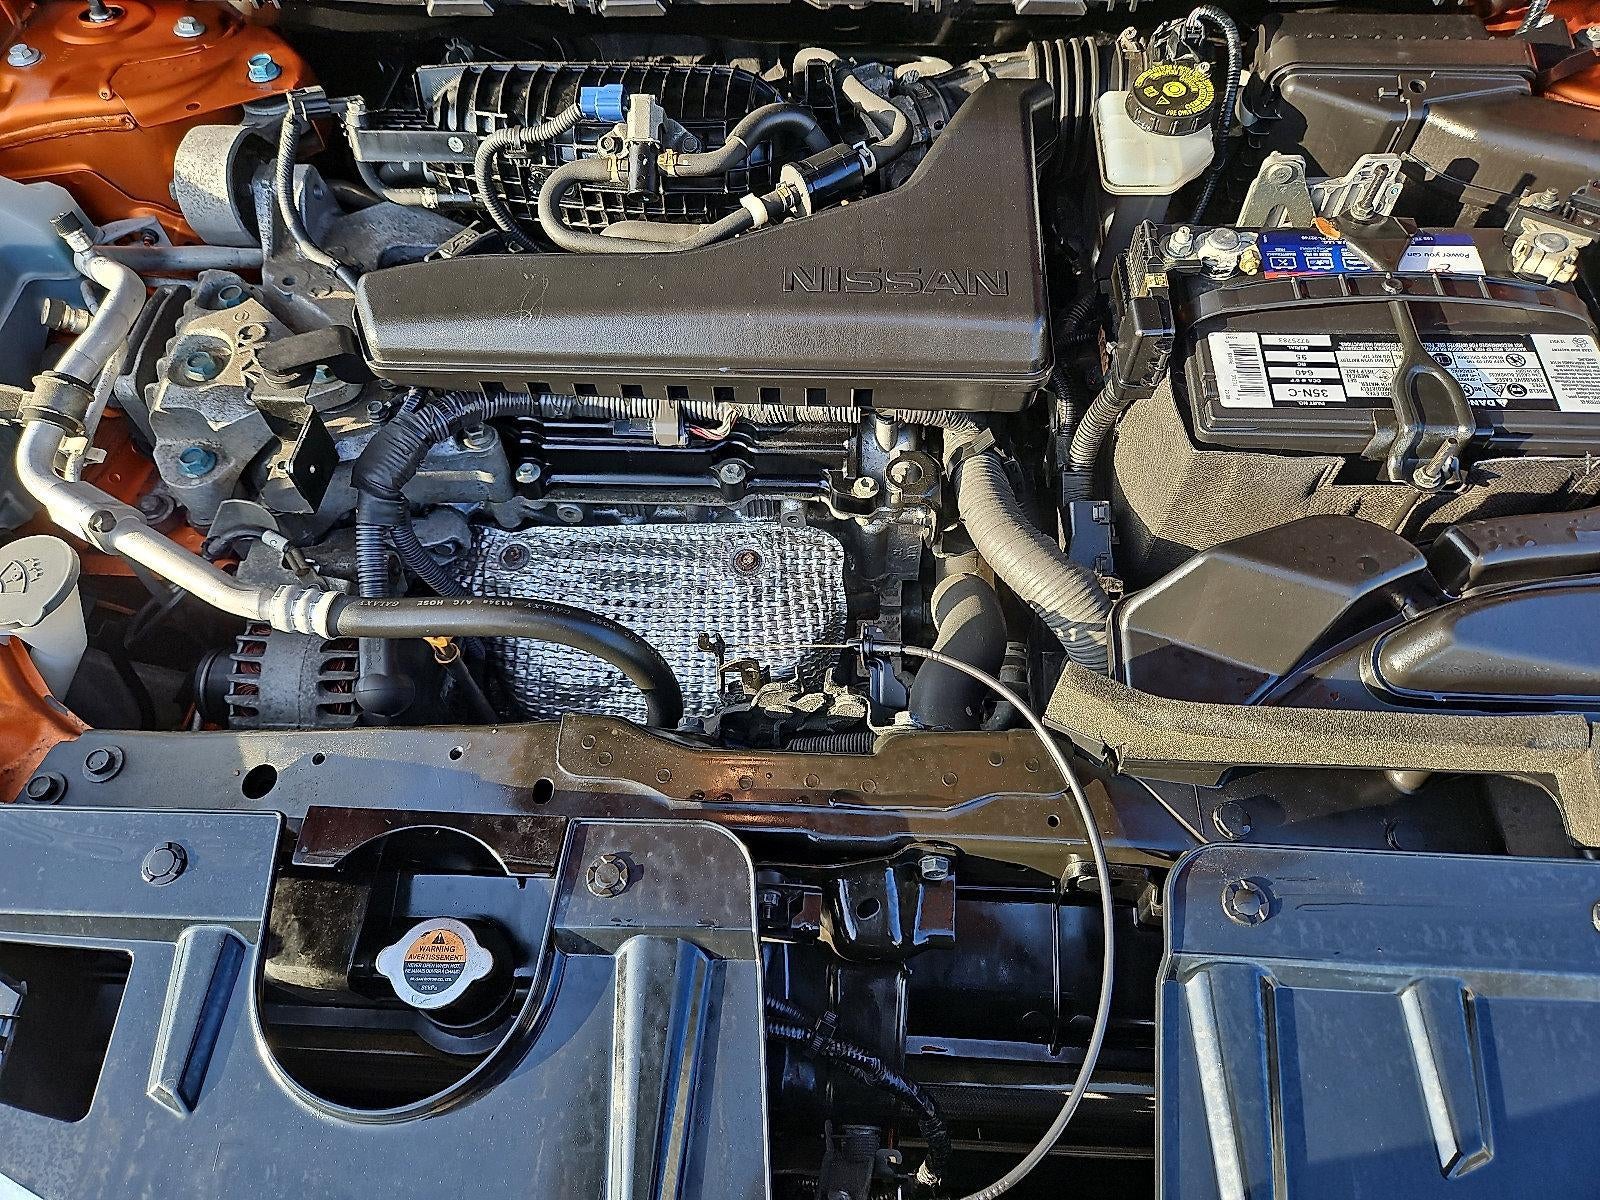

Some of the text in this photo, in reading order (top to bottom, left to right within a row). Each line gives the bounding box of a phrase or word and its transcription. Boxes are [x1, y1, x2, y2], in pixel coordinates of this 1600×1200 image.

[782, 266, 1009, 297] NISSAN
[1288, 388, 1328, 398] 35N-C
[419, 945, 456, 953] WARNING
[408, 953, 464, 961] AVERTISSEMENT
